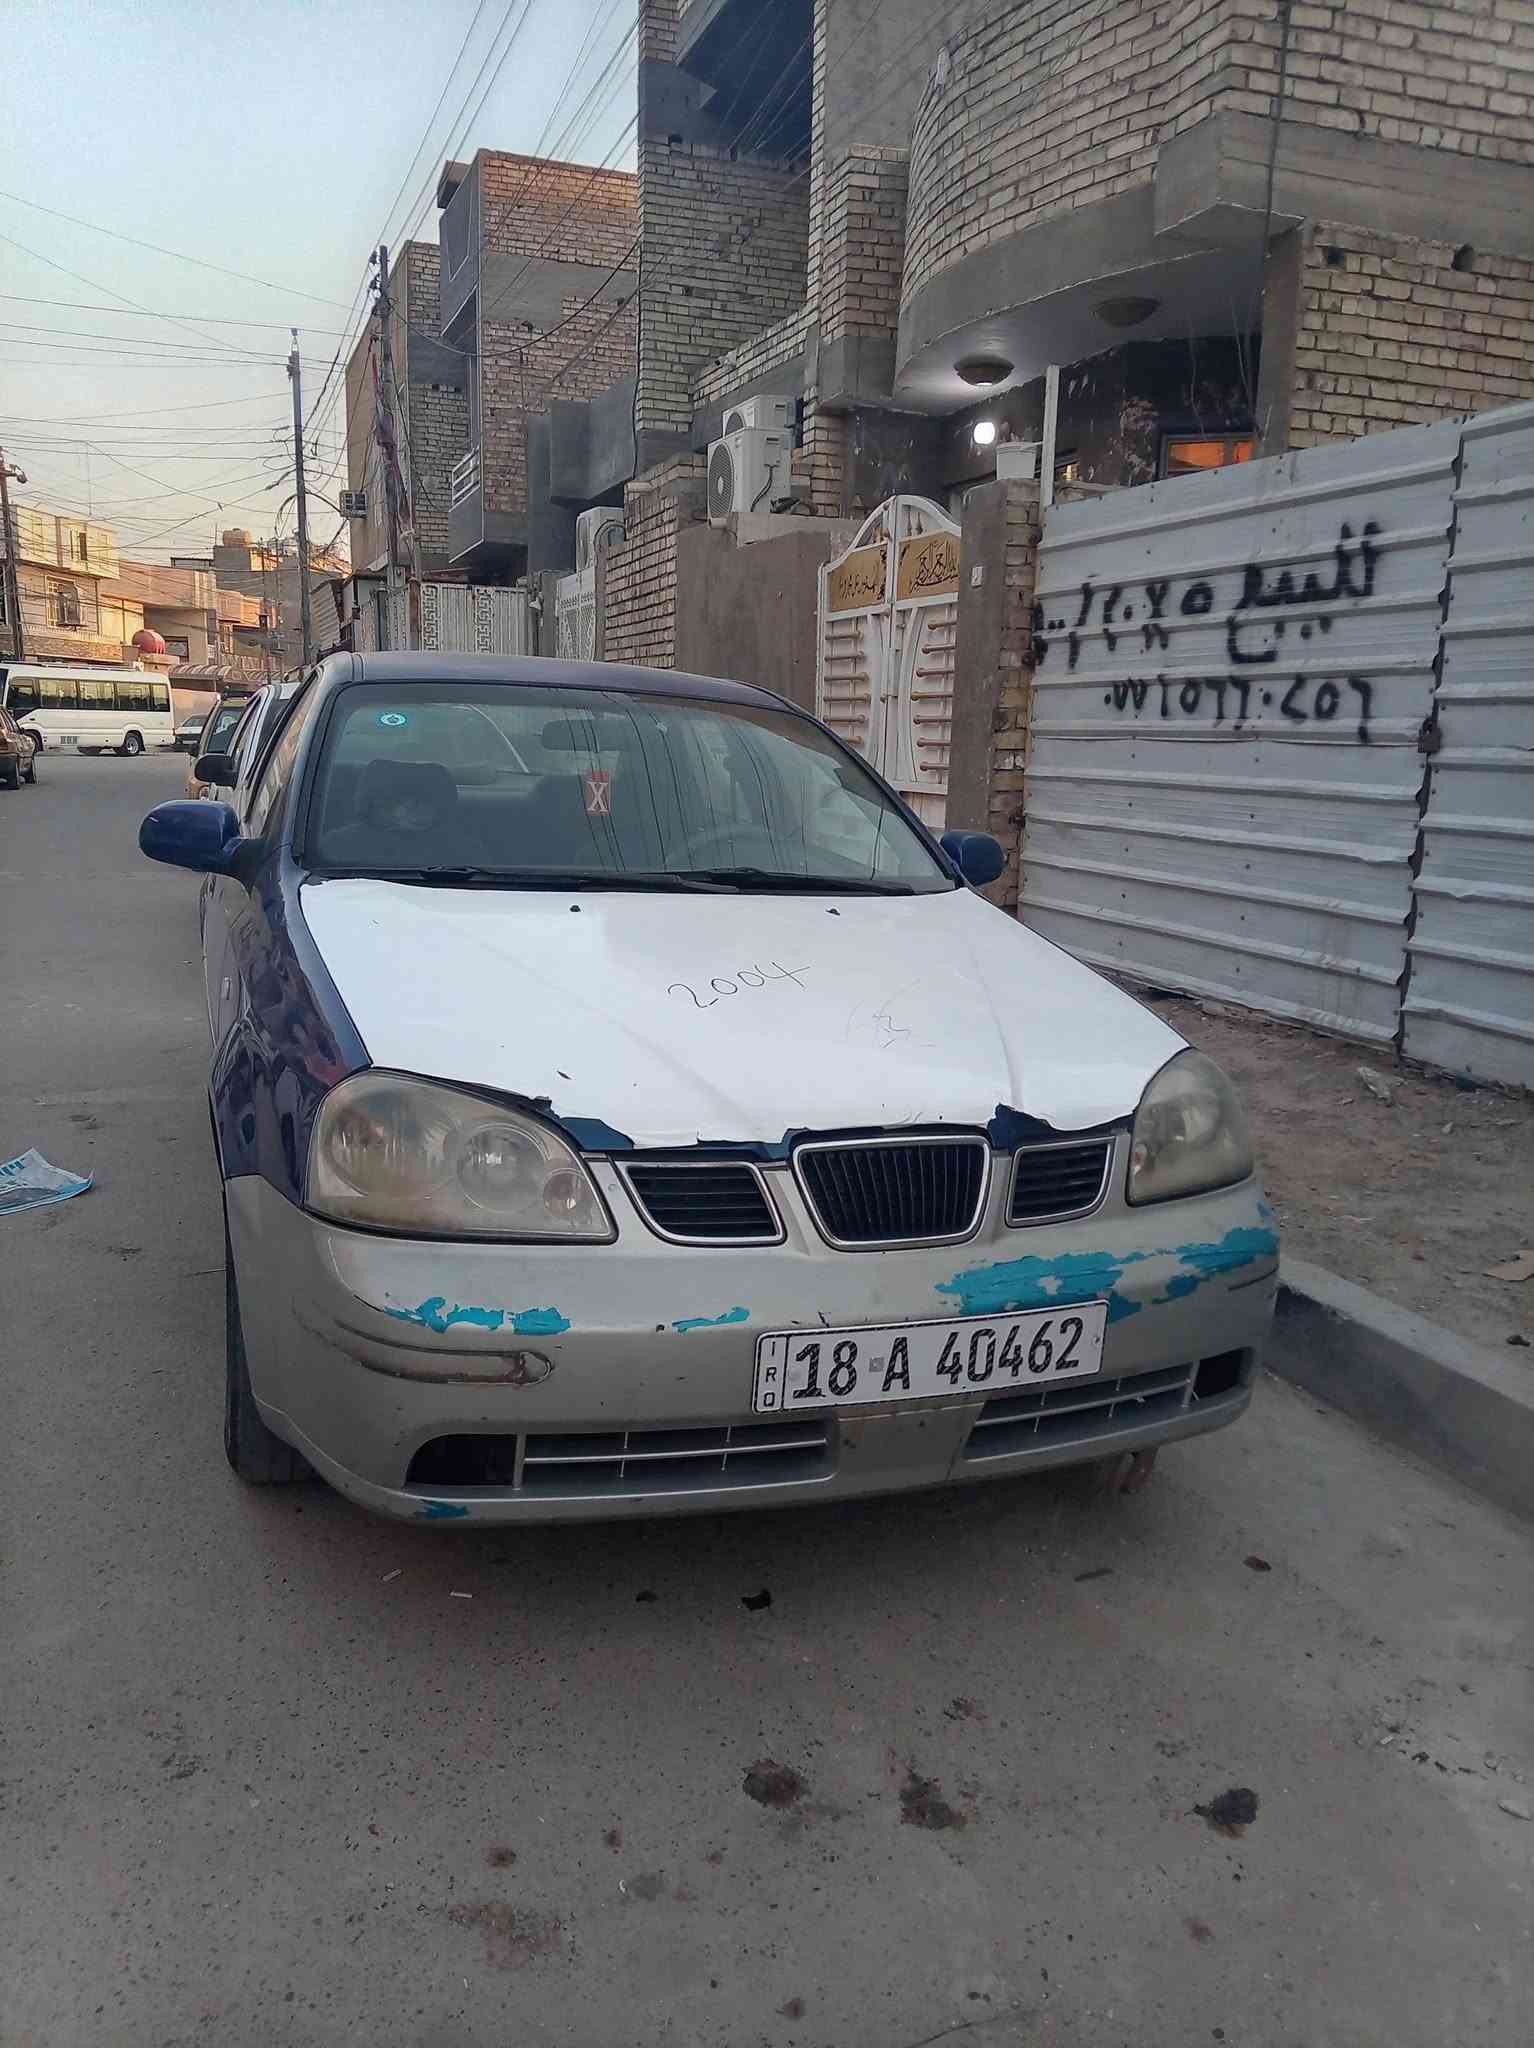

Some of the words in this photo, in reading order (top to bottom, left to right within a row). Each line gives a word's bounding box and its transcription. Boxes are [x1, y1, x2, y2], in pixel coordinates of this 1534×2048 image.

[667, 961, 811, 1008] 2004
[793, 1340, 858, 1399] 18
[882, 1336, 911, 1392] A
[936, 1316, 1084, 1385] 40462
